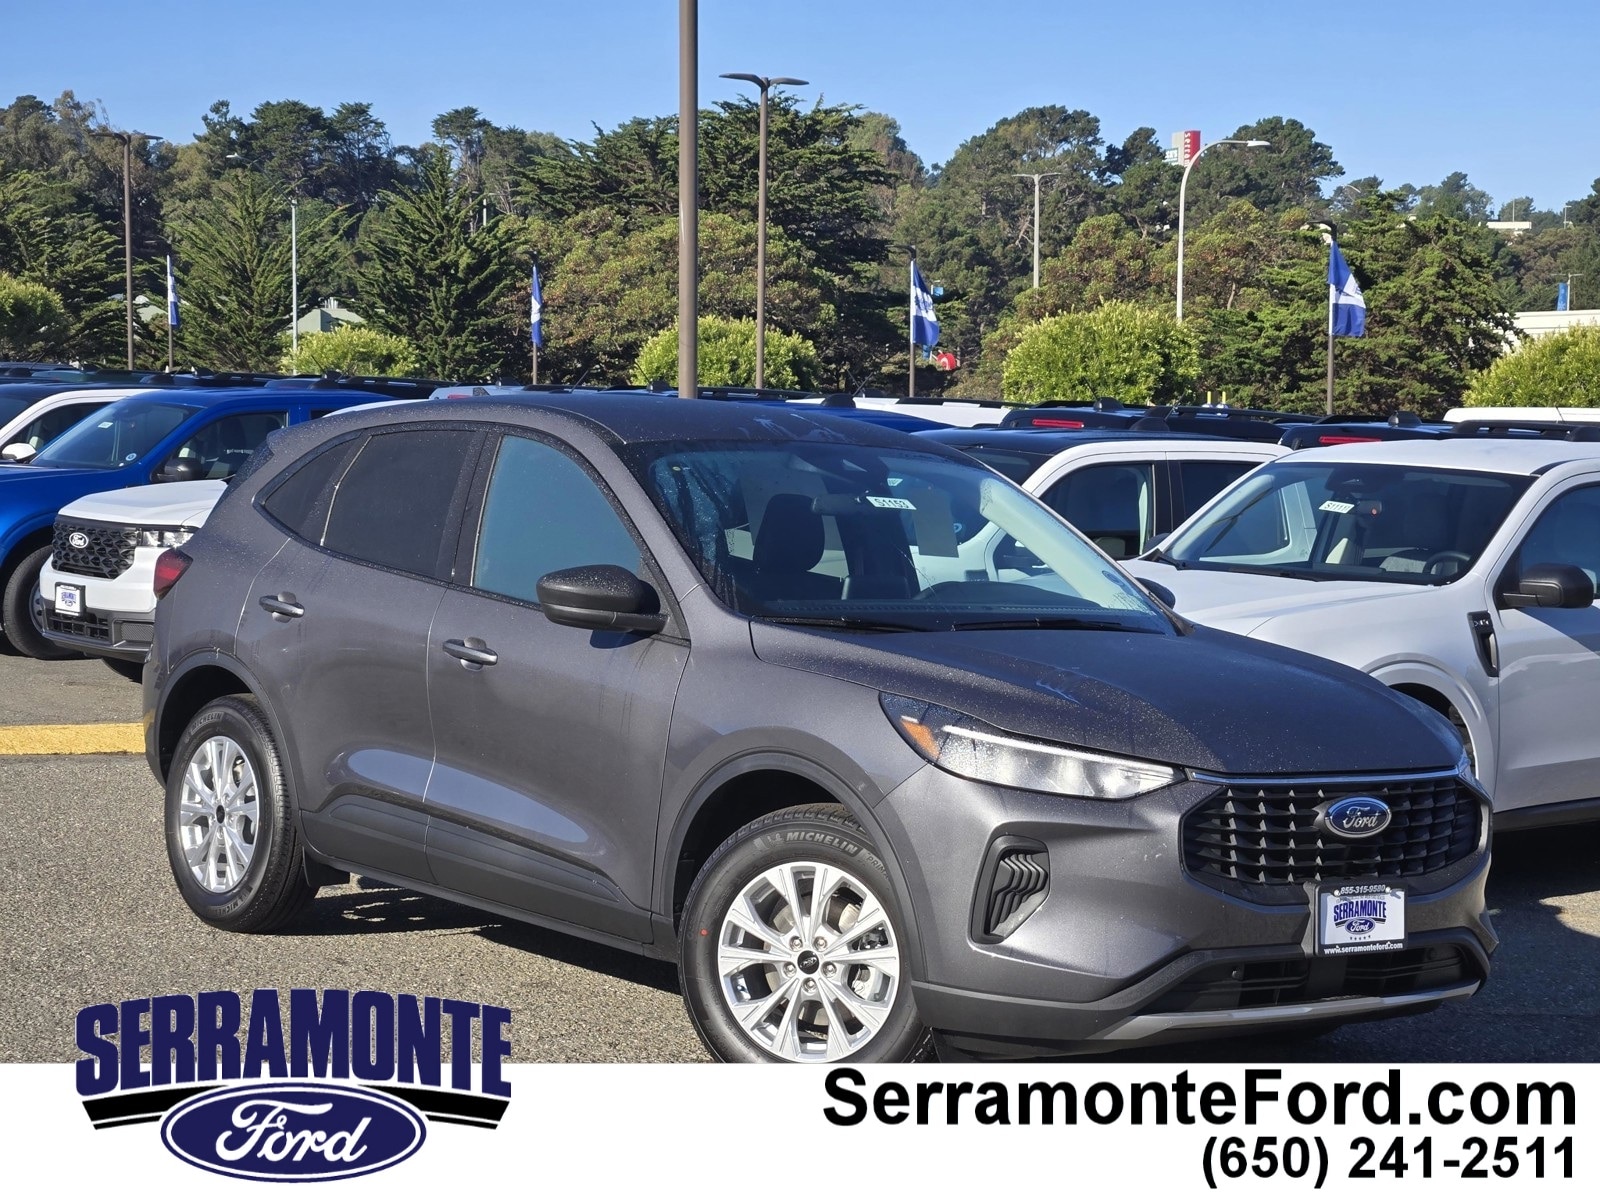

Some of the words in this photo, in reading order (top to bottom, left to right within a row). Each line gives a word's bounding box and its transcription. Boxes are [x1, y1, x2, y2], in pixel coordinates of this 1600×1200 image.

[1342, 805, 1380, 828] Ford
[786, 831, 858, 855] MICHELIN
[1333, 900, 1386, 922] SERRAMONTE
[1349, 920, 1371, 932] Ford
[1323, 942, 1403, 954] www.serramonteford.com
